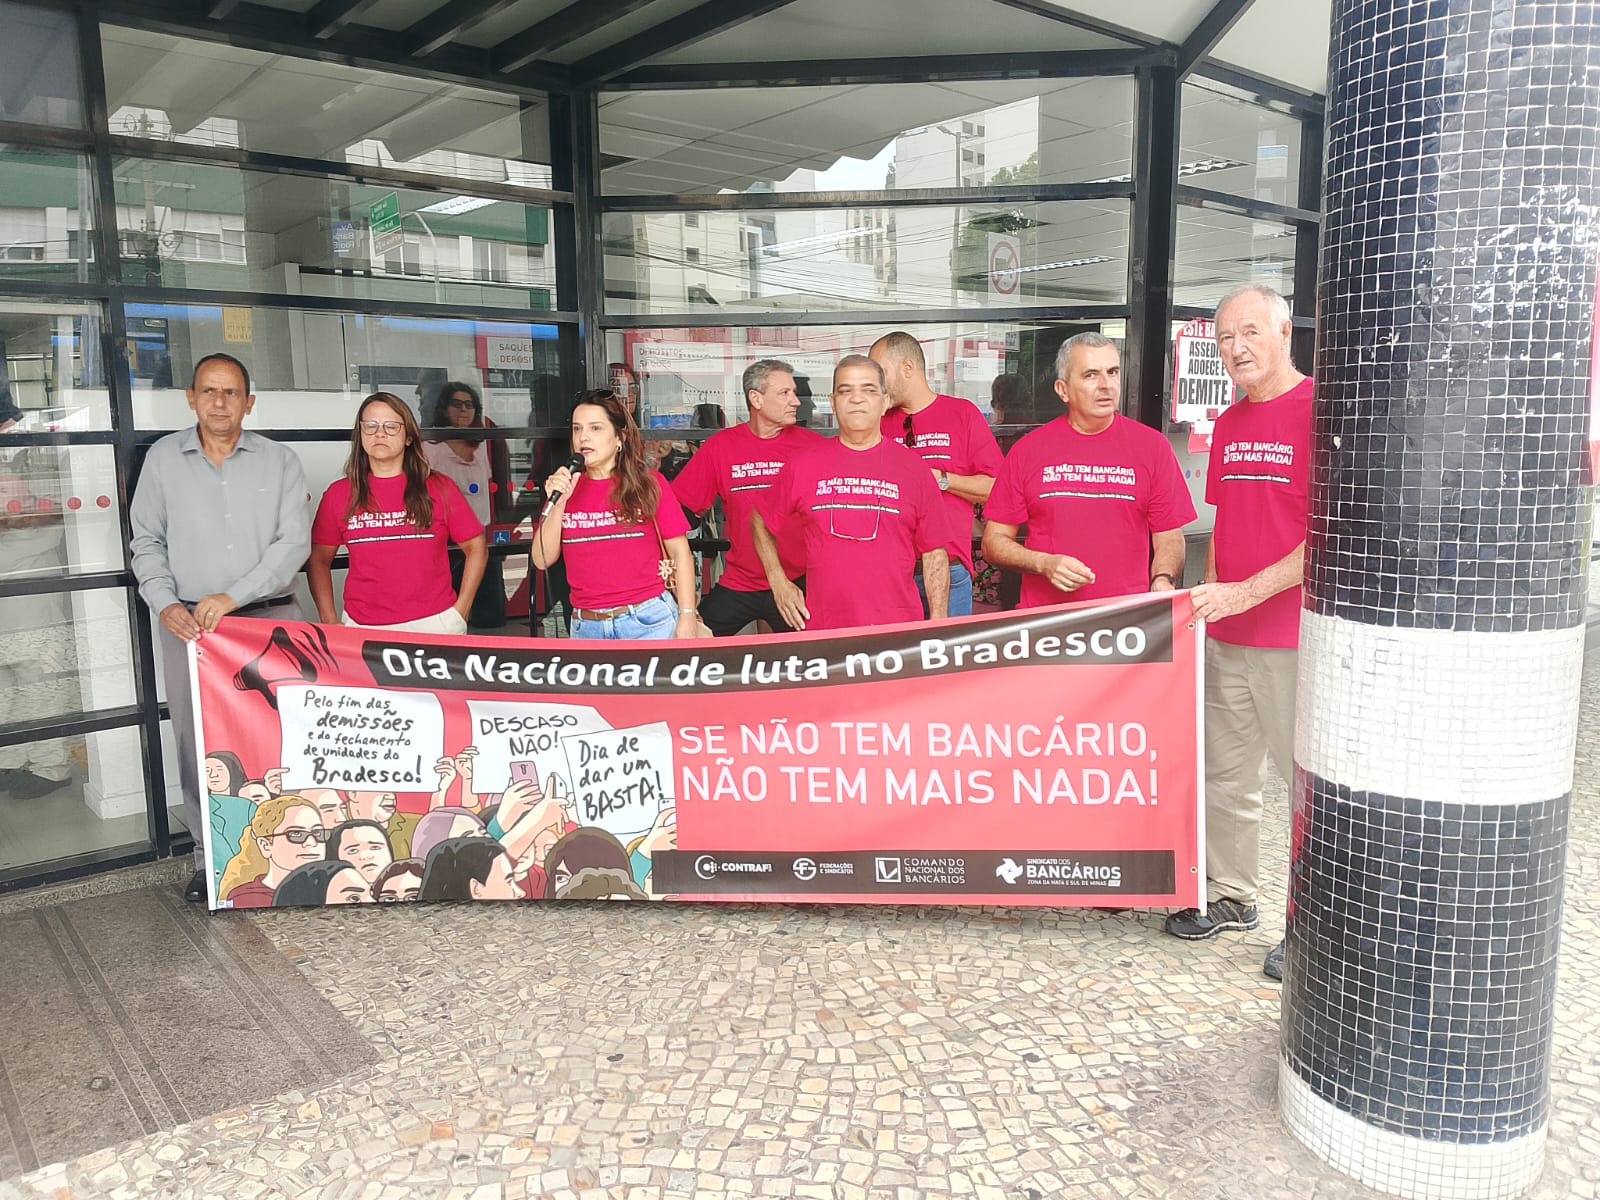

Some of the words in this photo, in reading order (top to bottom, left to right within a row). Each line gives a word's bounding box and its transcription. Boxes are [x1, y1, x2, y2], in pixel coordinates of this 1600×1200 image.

[1183, 322, 1204, 337] ESTE
[1188, 359, 1220, 376] ADOECE
[1178, 378, 1230, 405] DEMITE.
[1238, 442, 1251, 450] TEM
[1264, 452, 1293, 466] NADA!
[747, 469, 761, 477] TEM
[1044, 466, 1054, 475] SE
[1056, 464, 1073, 473] NÃO
[1075, 465, 1092, 473] TEM
[1093, 466, 1135, 476] BANCÁRIO,
[818, 480, 827, 488] SE
[828, 478, 843, 486] NÃO
[844, 478, 860, 486] TEM
[860, 478, 899, 492] BANCÁRIO,
[1042, 472, 1061, 483] NÃO
[1063, 474, 1082, 482] TEM
[1084, 474, 1105, 483] MAIS
[1108, 475, 1136, 486] NADA!
[816, 485, 832, 496] NÃO
[852, 486, 872, 495] MAIS
[874, 487, 899, 499] NADA!
[572, 511, 588, 520] NÃO
[578, 520, 595, 528] TEM
[596, 518, 616, 526] MAIS
[348, 520, 364, 530] NÃO
[365, 520, 383, 528] TEM
[382, 648, 452, 681] Dia
[464, 654, 659, 687] Nacional
[670, 656, 725, 687] de
[740, 653, 829, 685] luta
[845, 649, 902, 677] no
[920, 626, 1147, 670] Bradesco
[304, 690, 333, 708] Pelo
[338, 695, 361, 708] fim
[366, 697, 392, 709] das
[316, 709, 414, 731] demissões
[480, 714, 578, 735] DESCASO
[308, 731, 314, 740] e
[318, 730, 331, 740] do
[334, 732, 411, 746] fechamento
[510, 731, 559, 756] NÃO!
[679, 725, 728, 755] SE
[740, 717, 820, 755] NÃO
[830, 721, 912, 756] TEM
[928, 714, 1157, 763] BANCÁRIO,
[304, 744, 318, 756] de
[323, 747, 378, 760] unidades
[384, 748, 400, 760] do
[579, 740, 609, 767] Dia
[616, 736, 640, 753] de
[312, 755, 422, 785] Bradesco!
[579, 766, 615, 788] dar
[623, 760, 651, 776] um
[682, 757, 767, 802] NÃO
[780, 766, 867, 804] TEM
[885, 768, 995, 806] MAIS
[1012, 768, 1158, 806] NADA!
[583, 770, 665, 821] BASTA!
[904, 858, 965, 867] COMANDO
[904, 866, 946, 874] NACIONAL
[948, 866, 965, 875] DOS
[904, 873, 966, 884] BANCÁRIOS
[1026, 862, 1121, 880] BANCÁRIOS
